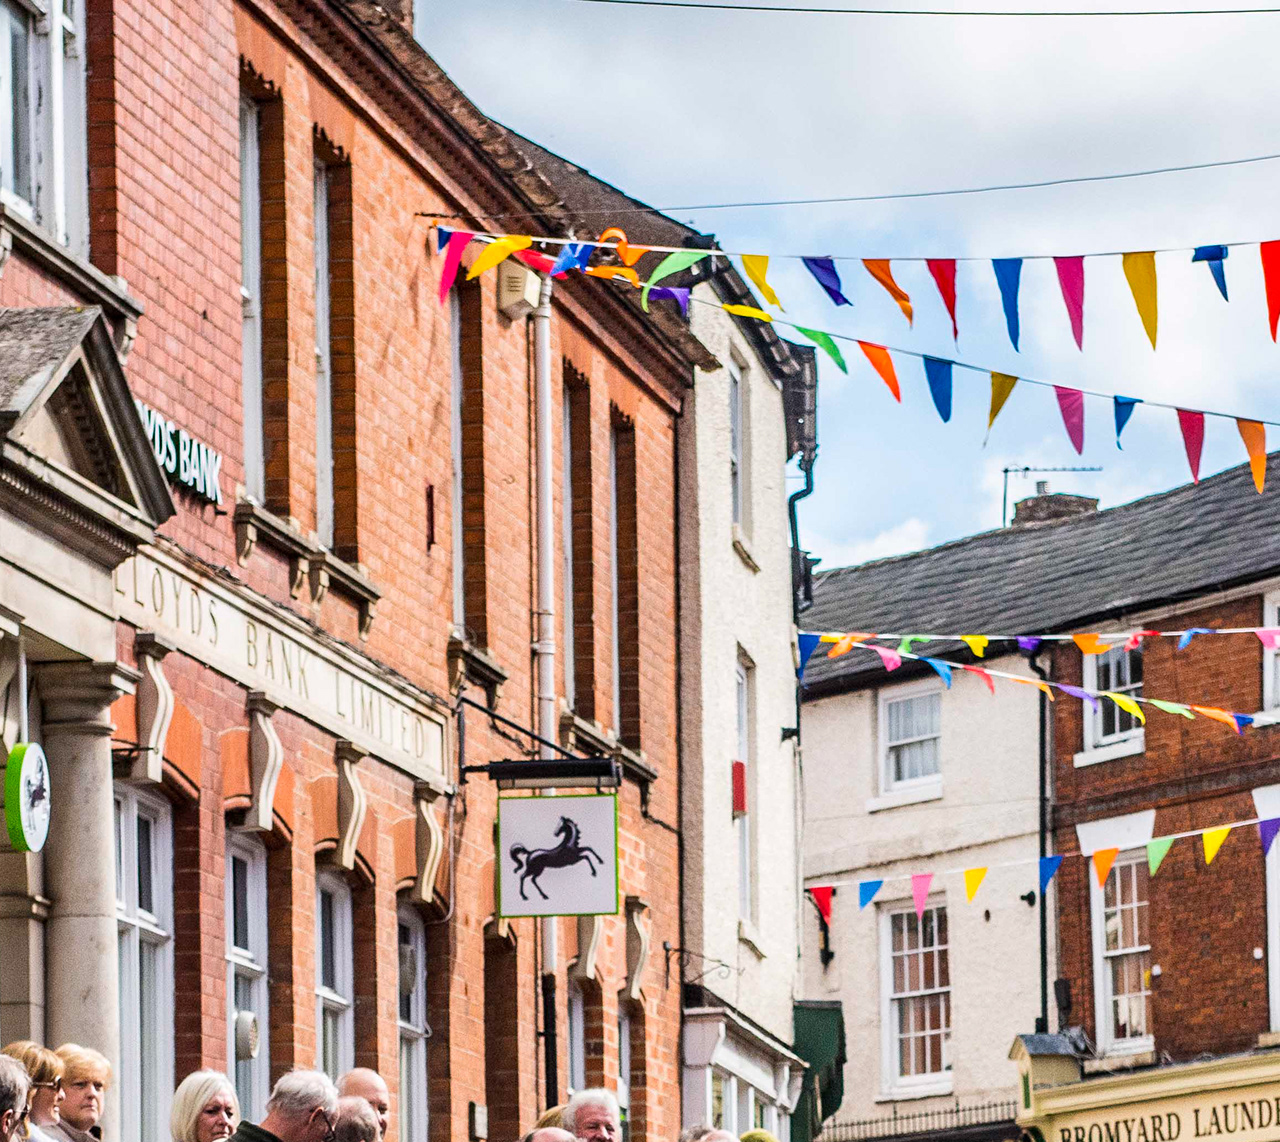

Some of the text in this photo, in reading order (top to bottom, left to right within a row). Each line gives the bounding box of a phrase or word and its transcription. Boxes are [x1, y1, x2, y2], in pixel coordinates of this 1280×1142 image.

[179, 429, 223, 505] BANK
[246, 620, 310, 699] BANK
[335, 670, 426, 760] LIMITED
